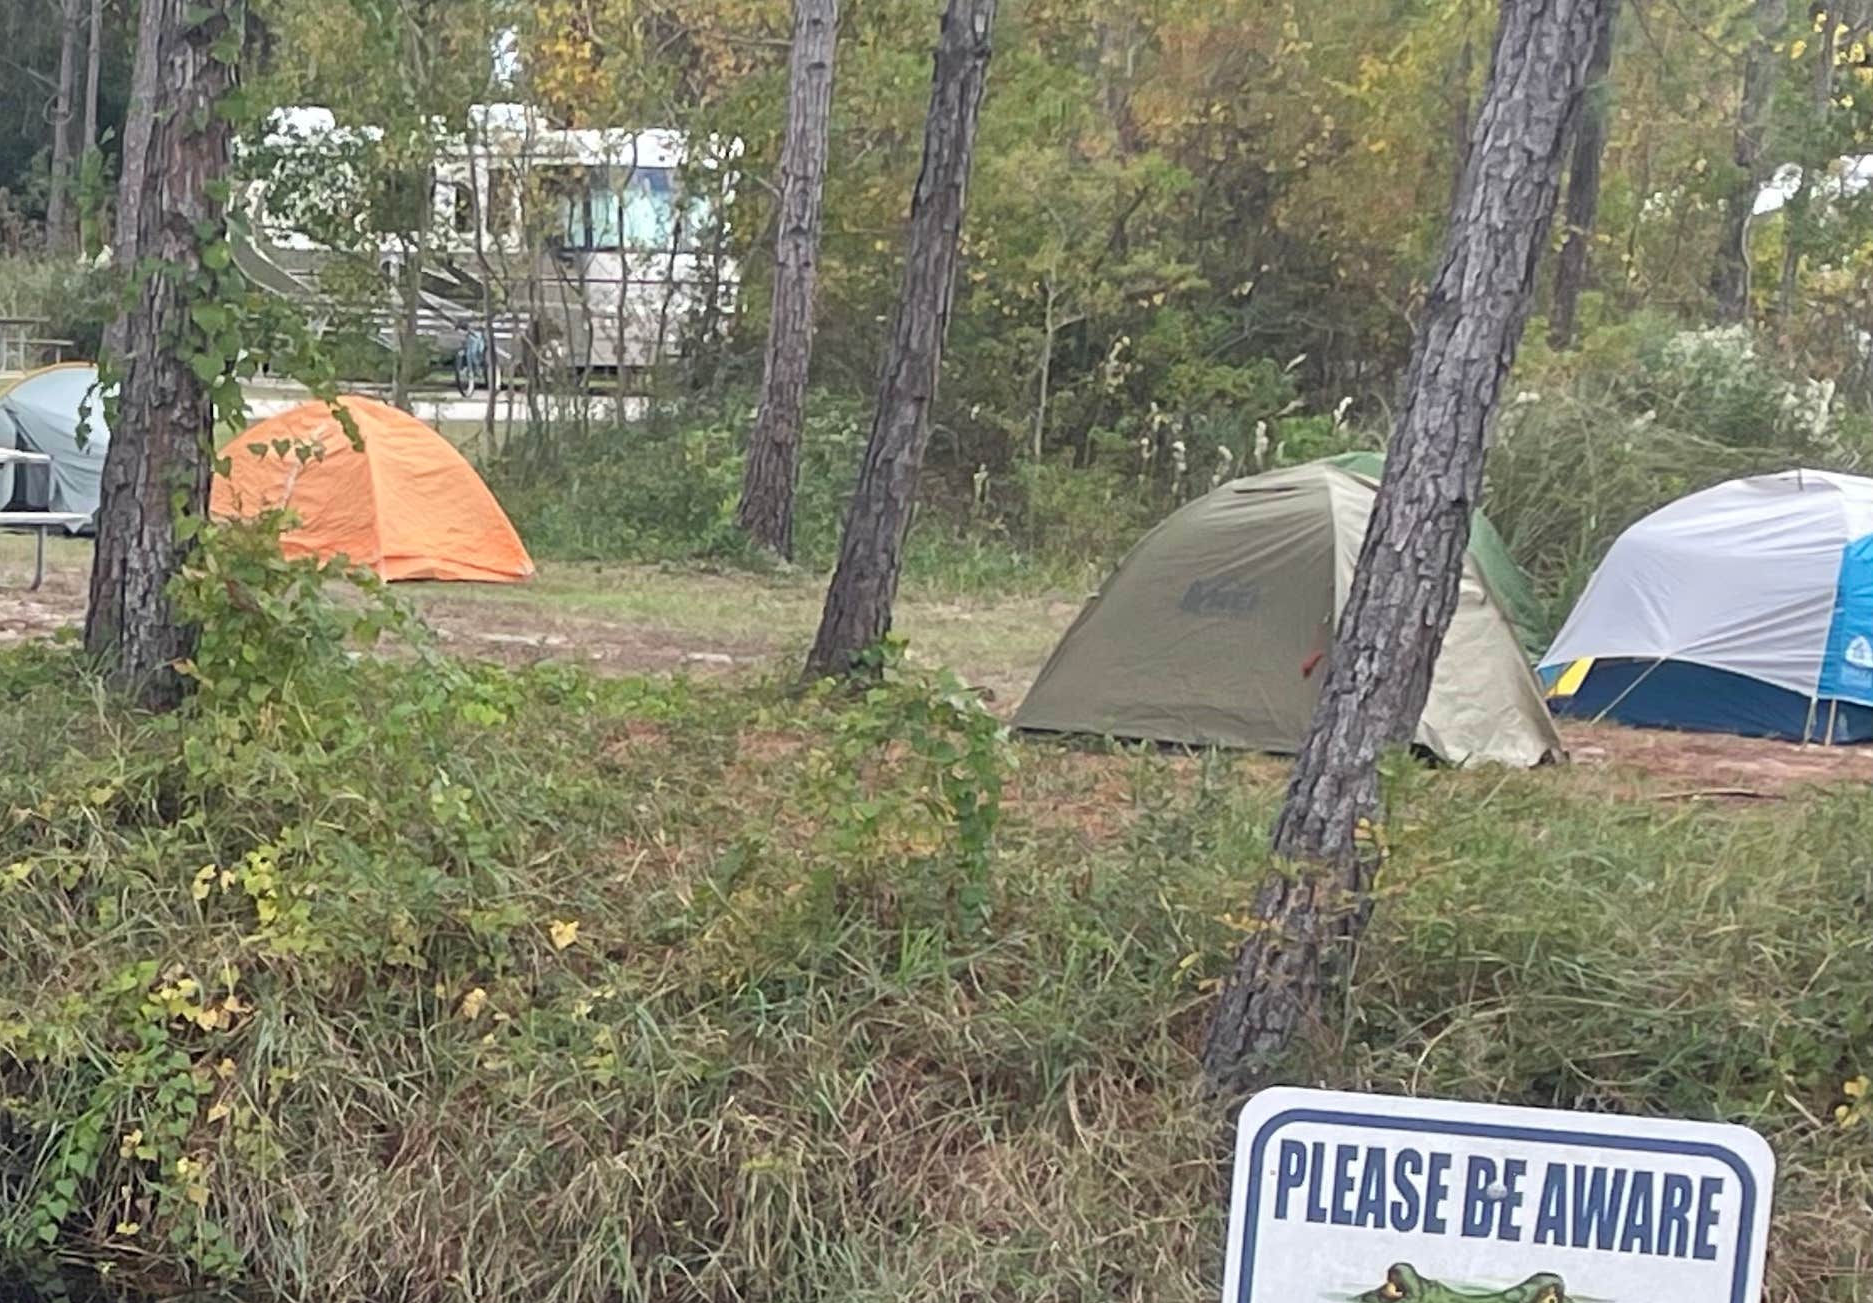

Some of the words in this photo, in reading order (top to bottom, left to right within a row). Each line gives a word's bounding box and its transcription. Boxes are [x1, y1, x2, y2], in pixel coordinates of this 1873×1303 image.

[1274, 1139, 1452, 1234] PLEASE
[1461, 1155, 1527, 1241] BE
[1533, 1162, 1725, 1260] AWARE
